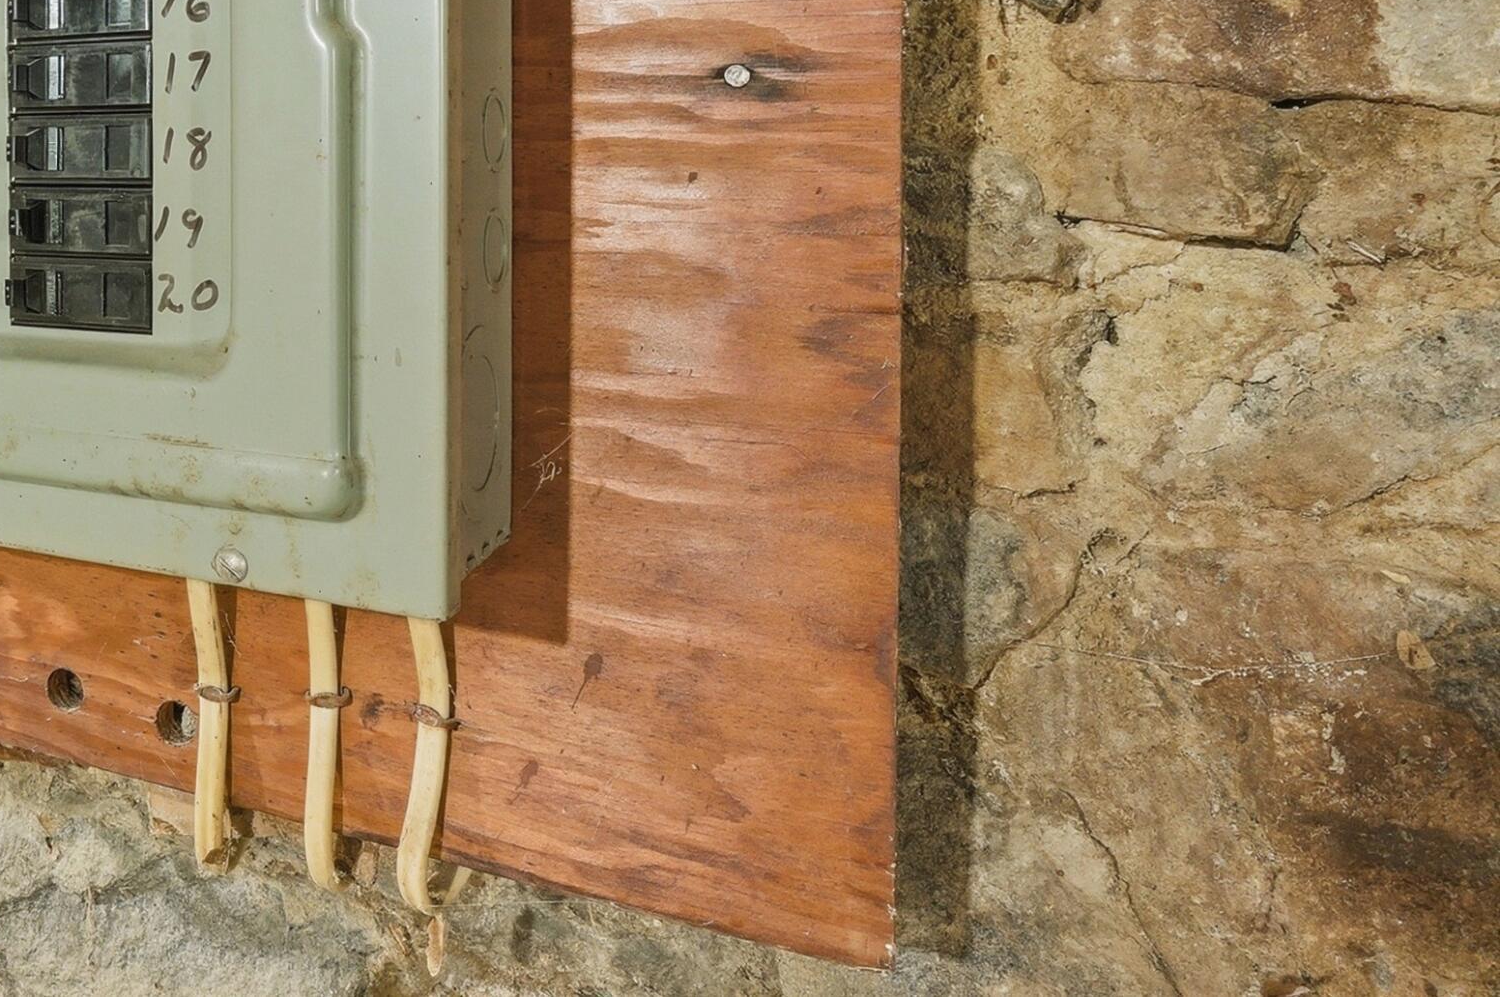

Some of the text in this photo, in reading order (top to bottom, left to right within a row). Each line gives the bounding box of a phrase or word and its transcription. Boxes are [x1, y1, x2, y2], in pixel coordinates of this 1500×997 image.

[165, 50, 212, 94] 17
[163, 126, 212, 172] 18
[154, 206, 204, 249] 19
[157, 273, 220, 314] 20
